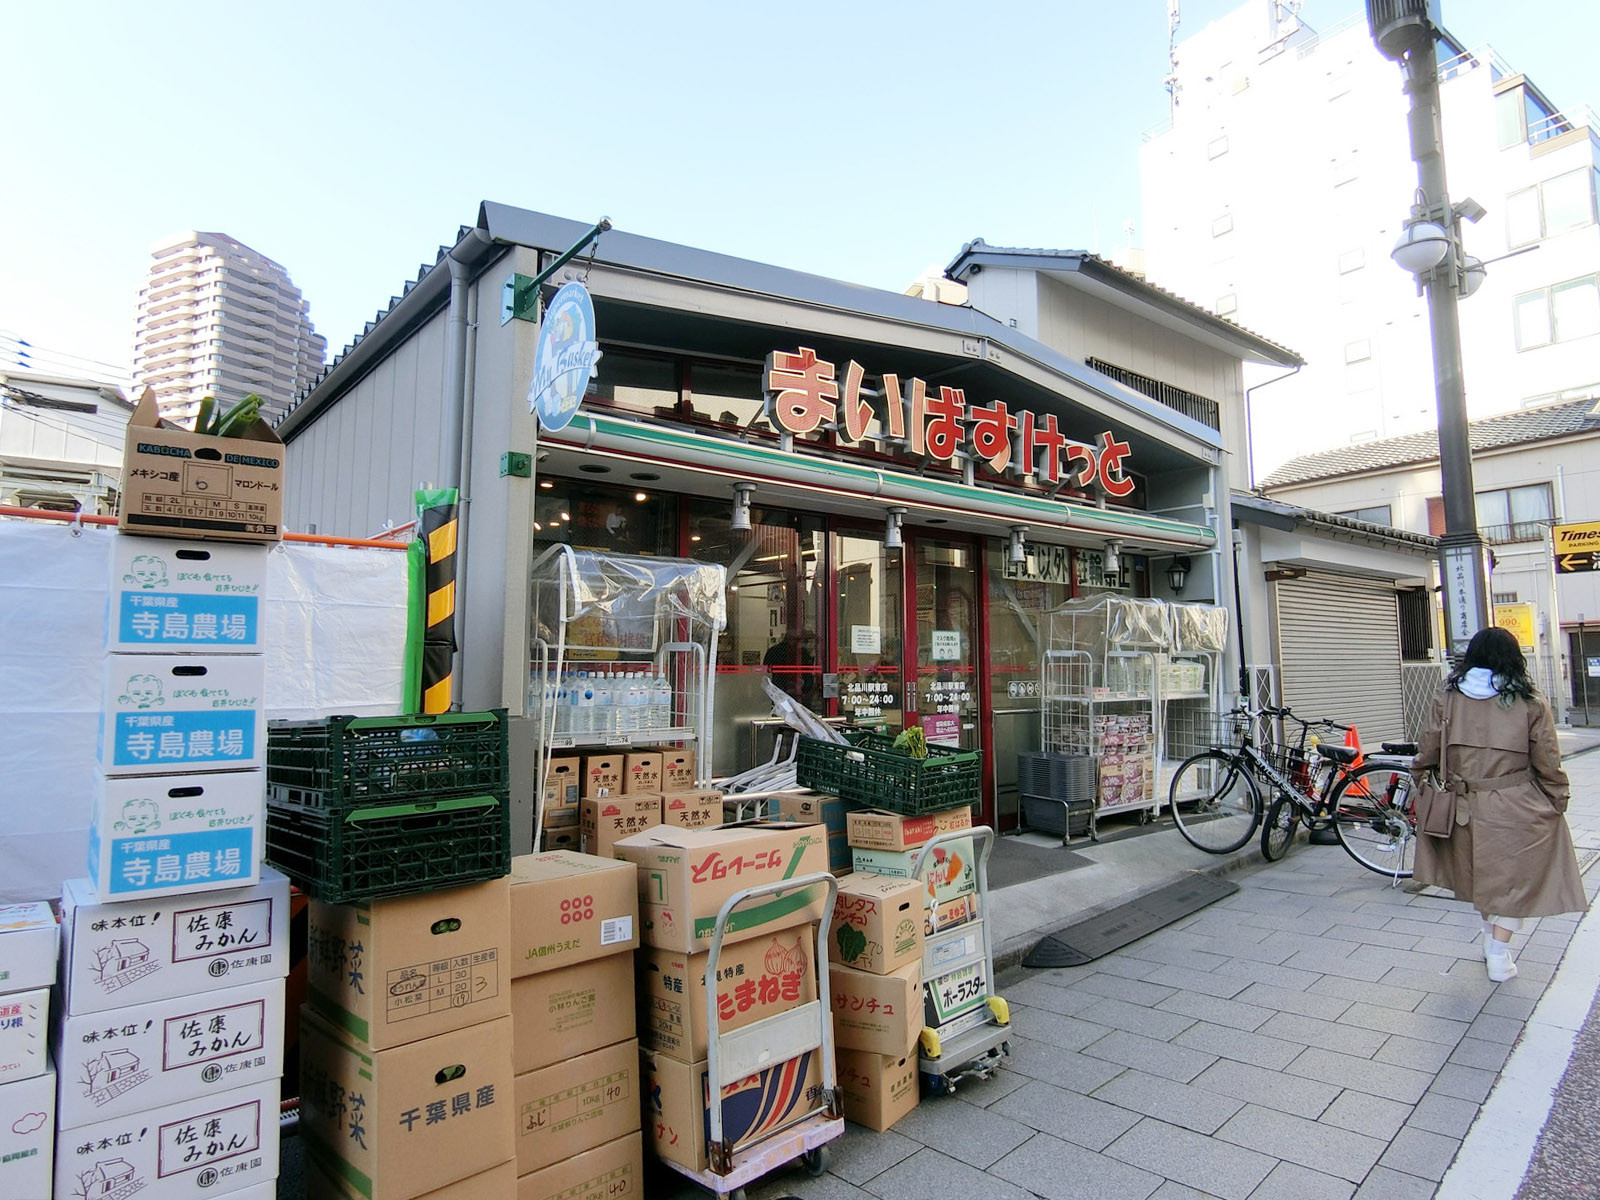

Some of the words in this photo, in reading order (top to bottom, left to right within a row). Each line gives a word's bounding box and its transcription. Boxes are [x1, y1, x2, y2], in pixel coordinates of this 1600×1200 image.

[768, 346, 1136, 497] まいばすけっと
[225, 454, 240, 464] DE
[242, 456, 279, 469] MEXICO
[130, 468, 180, 483] メキシコ産
[235, 479, 279, 492] マロンドール
[1568, 540, 1600, 548] PARKING
[130, 595, 178, 608] 千葉県産
[132, 611, 247, 641] 寺島農場
[124, 715, 174, 728] 千葉県産
[126, 729, 244, 761] 寺島農場
[593, 774, 619, 784] 天然水
[634, 772, 658, 780] 天然水
[669, 769, 692, 778] 天然水
[614, 815, 648, 829] 天然水
[680, 809, 711, 823] 天然水
[120, 839, 171, 854] 千葉県産
[122, 848, 241, 886] 寺島農場
[690, 848, 782, 884] サニーレタス
[651, 874, 663, 900] L
[186, 911, 233, 933] 佐康
[195, 928, 257, 951] みかん
[525, 938, 580, 960] JA信州うえだ
[230, 954, 272, 968] 佐康園
[455, 970, 467, 979] 30
[436, 988, 444, 996] M
[455, 983, 467, 992] 20
[717, 970, 801, 1021] たまねぎ
[394, 993, 422, 1006] 小松菜
[835, 993, 894, 1015] サンチュ
[180, 1015, 227, 1039] 佐康
[188, 1032, 252, 1057] みかん
[224, 1056, 266, 1073] 佐康園
[606, 1086, 621, 1101] 40
[399, 1084, 495, 1132] 千葉県産
[526, 1108, 546, 1130] ふじ
[175, 1118, 222, 1145] 佐康
[183, 1134, 248, 1163] みかん
[219, 1157, 262, 1178] 佐康園
[608, 1179, 626, 1196] 40
